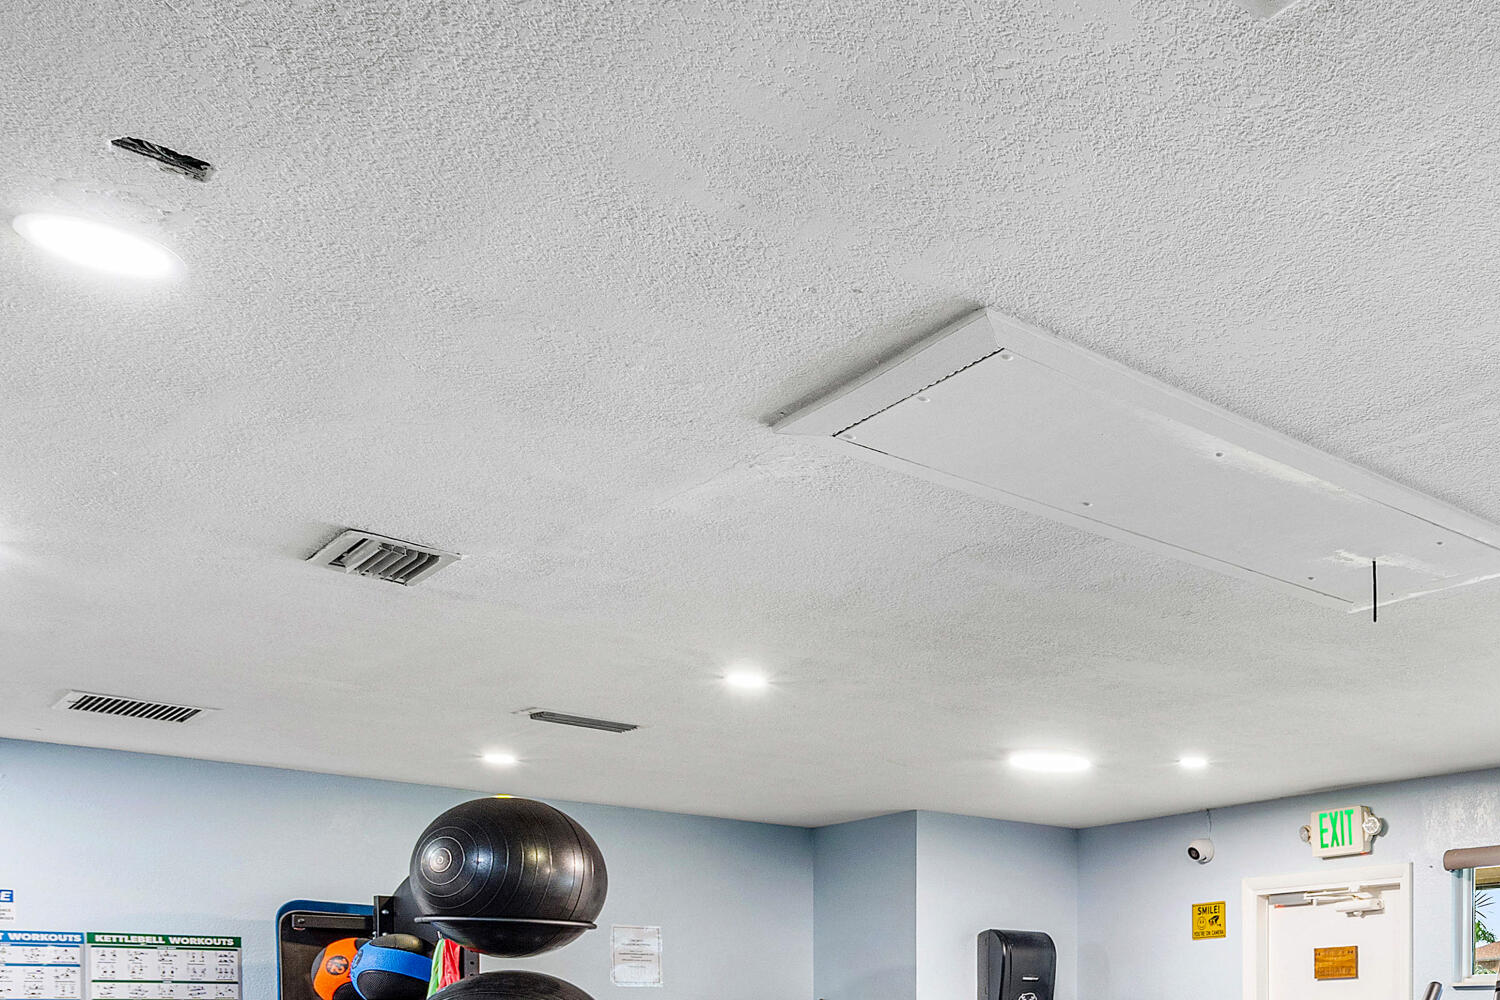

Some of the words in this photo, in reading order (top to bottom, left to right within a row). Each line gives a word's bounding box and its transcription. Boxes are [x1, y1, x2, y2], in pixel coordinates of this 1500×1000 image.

[1318, 809, 1354, 849] EXIT
[1197, 905, 1221, 915] SMILE!
[7, 932, 82, 942] WORKOUTS
[95, 934, 166, 944] KETTLEBELL
[168, 936, 235, 946] WORKOUTS
